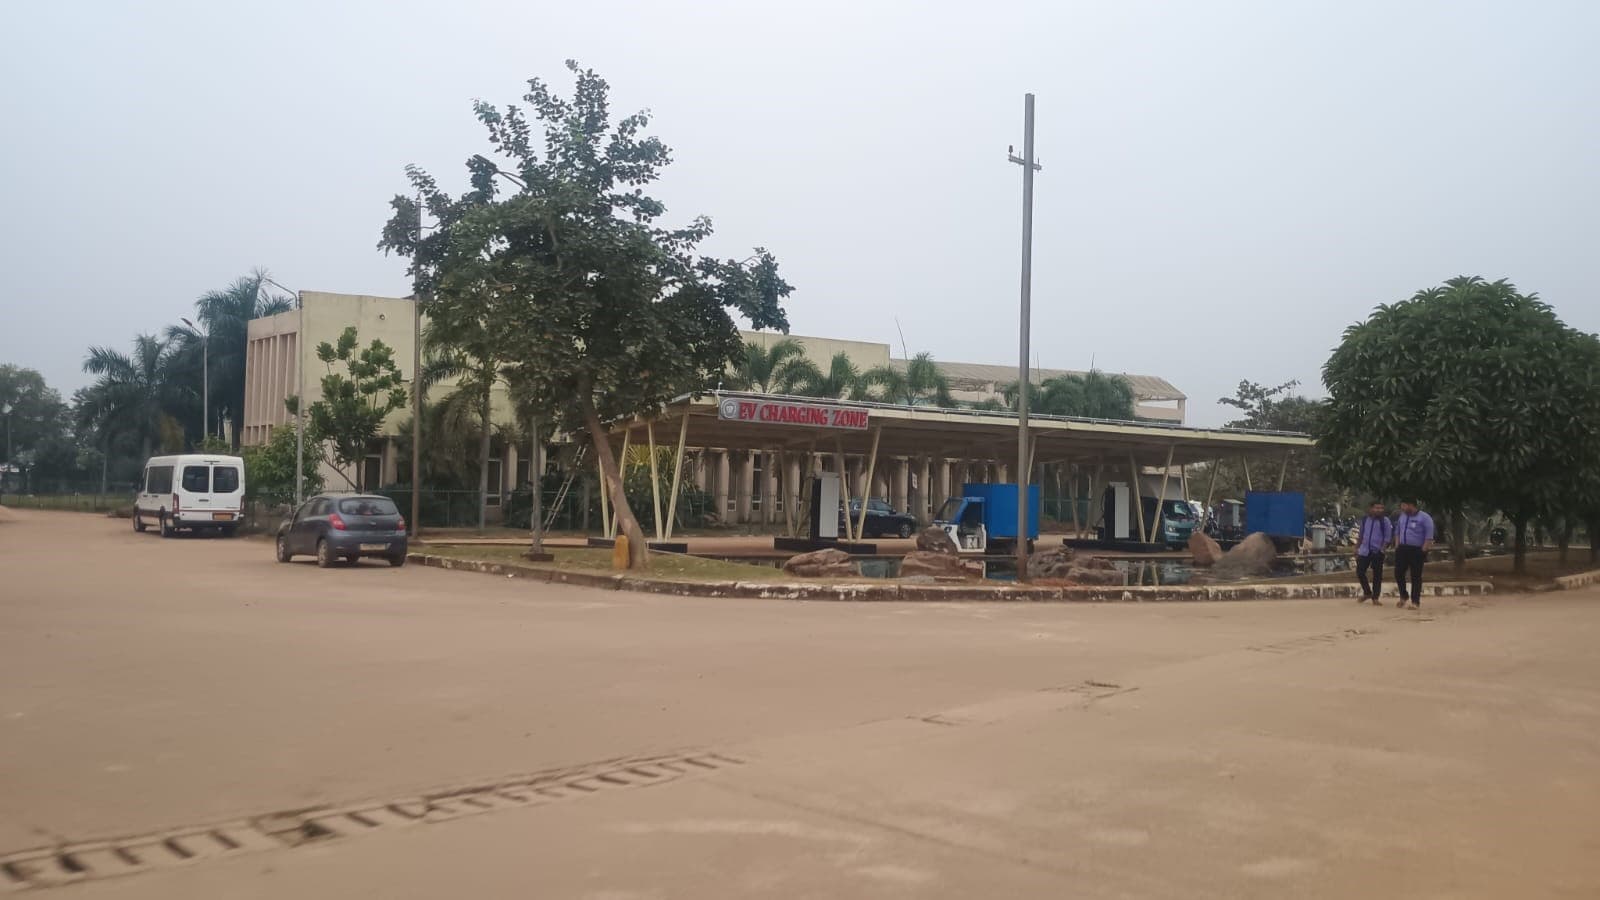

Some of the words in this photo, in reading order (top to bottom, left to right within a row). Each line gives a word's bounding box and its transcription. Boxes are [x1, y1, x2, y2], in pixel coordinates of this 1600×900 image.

[739, 402, 757, 420] EV
[760, 403, 828, 425] CHARGING
[832, 409, 868, 427] ZONE
